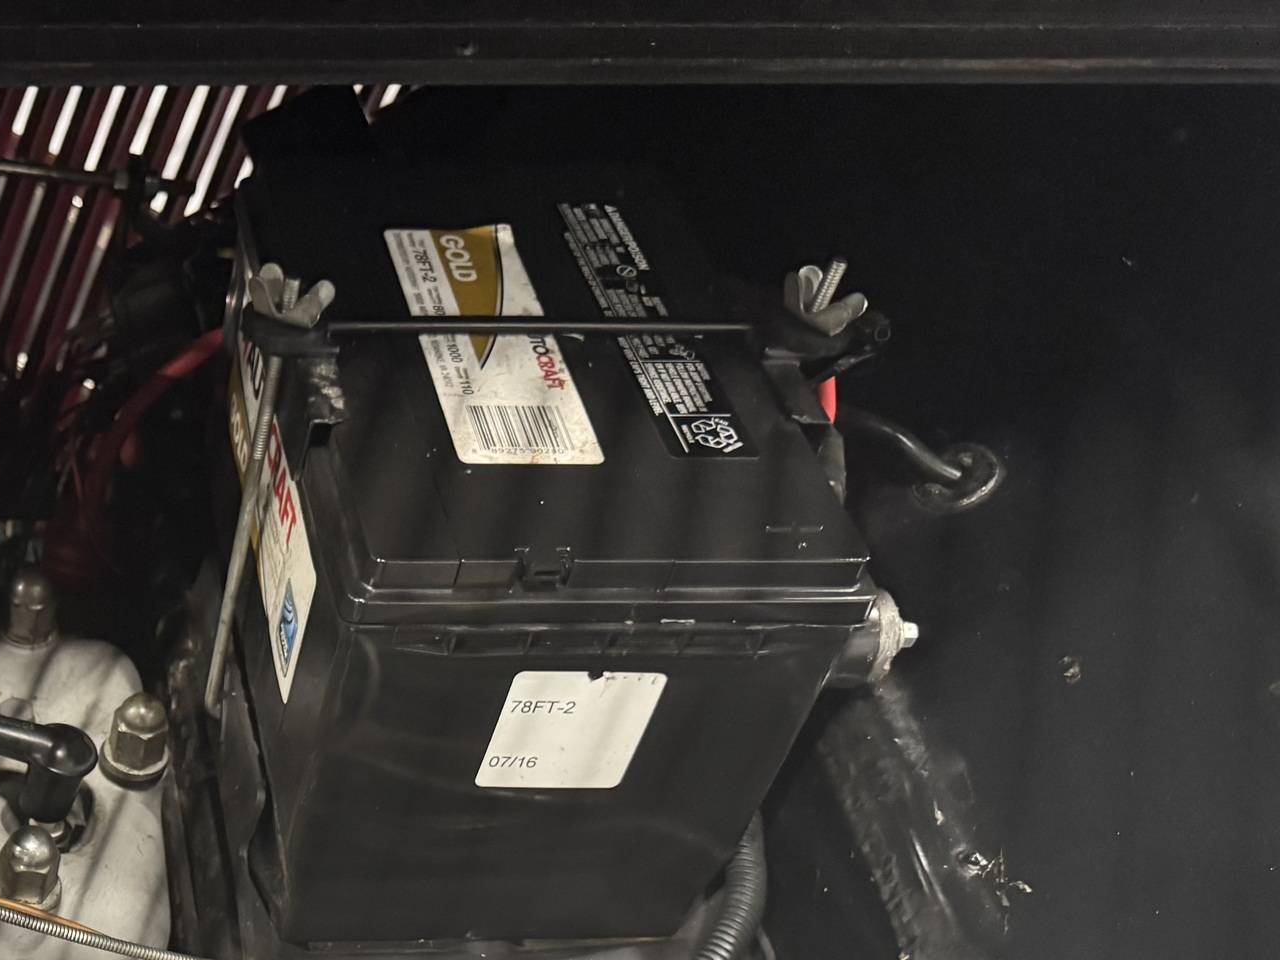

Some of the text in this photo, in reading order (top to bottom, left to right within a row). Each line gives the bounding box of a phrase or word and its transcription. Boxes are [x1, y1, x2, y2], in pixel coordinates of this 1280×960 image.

[412, 249, 438, 283] 78FT-2
[439, 234, 478, 282] GOLD
[445, 343, 463, 364] 1000
[526, 334, 566, 391] TOCRAFT
[459, 378, 475, 396] 110
[510, 700, 577, 715] 78FT-2
[488, 755, 539, 769] 07/16
